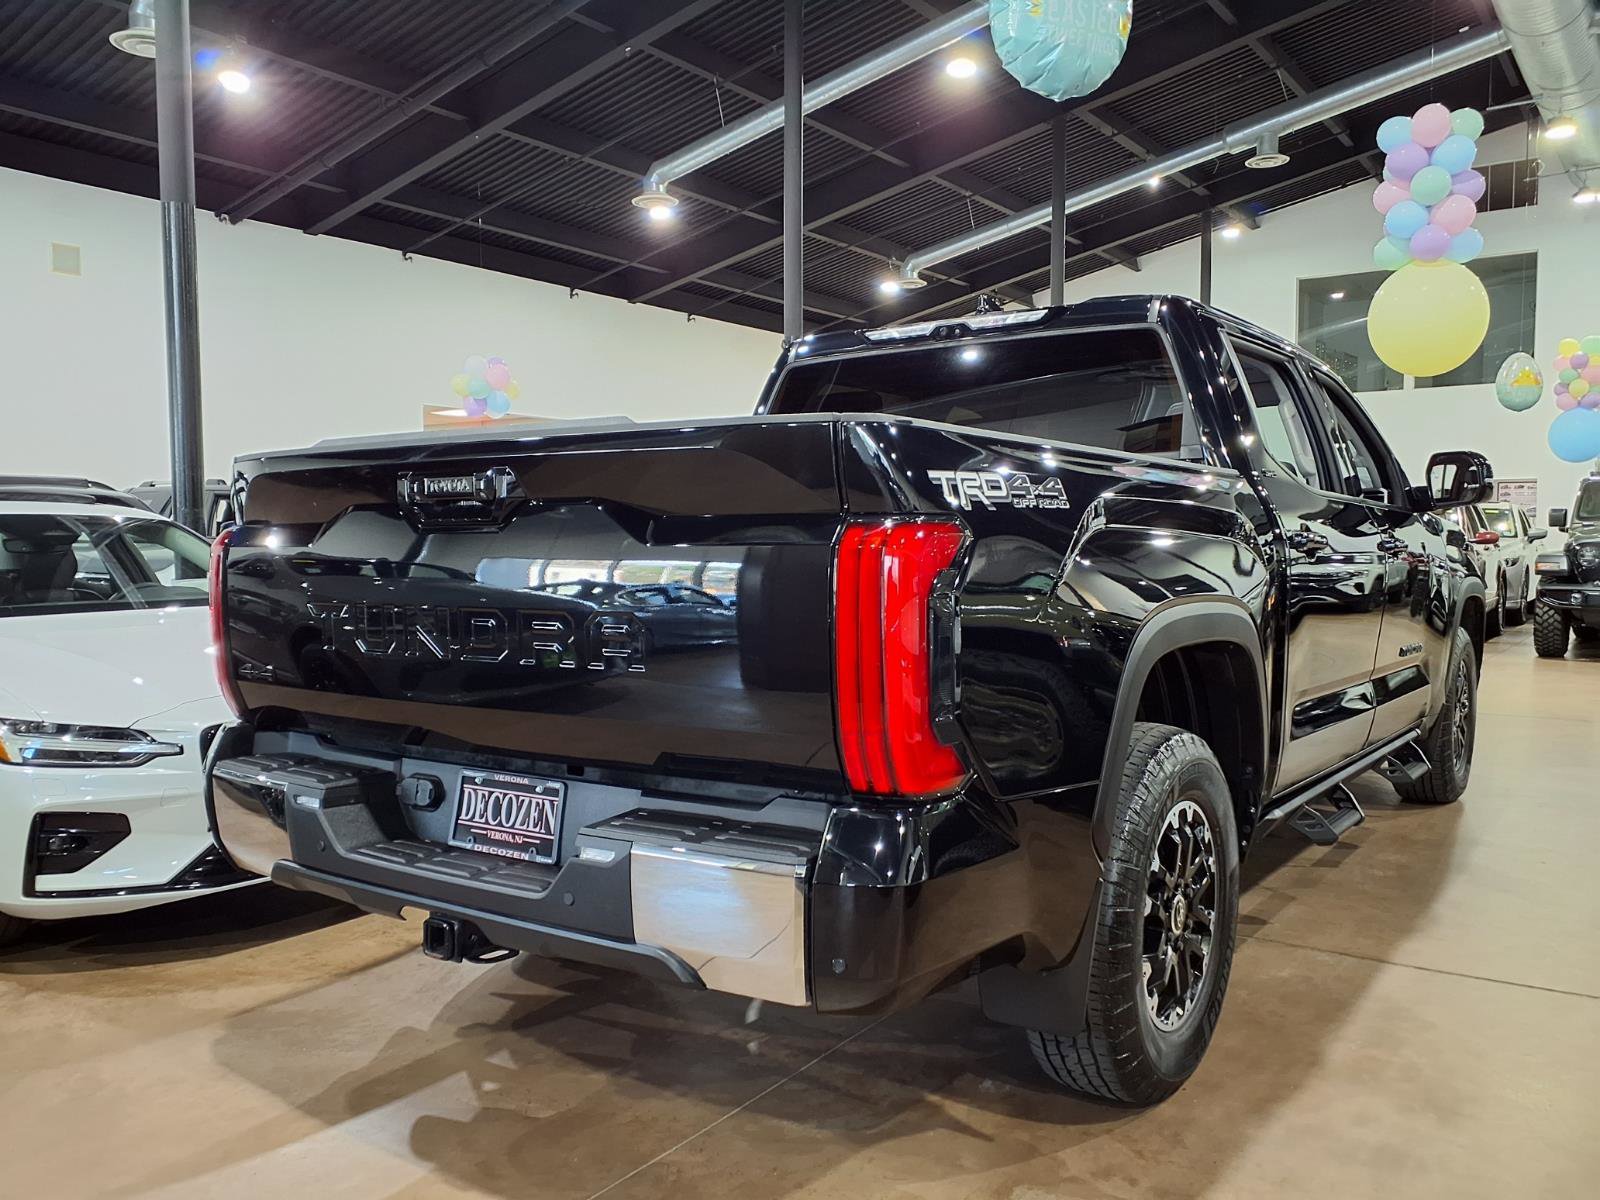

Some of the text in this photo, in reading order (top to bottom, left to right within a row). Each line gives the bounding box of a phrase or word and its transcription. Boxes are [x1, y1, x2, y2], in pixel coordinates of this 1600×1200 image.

[1048, 0, 1119, 33] EASTER
[429, 479, 471, 493] TOYOTA
[926, 469, 1012, 511] TRD
[1013, 498, 1070, 509] OFF ROAD
[306, 602, 646, 673] TUNDRA
[494, 774, 529, 785] VERONA
[459, 788, 558, 835] DECOZEN
[486, 829, 524, 844] VERONA, NJ
[473, 845, 530, 861] DECOZEN
